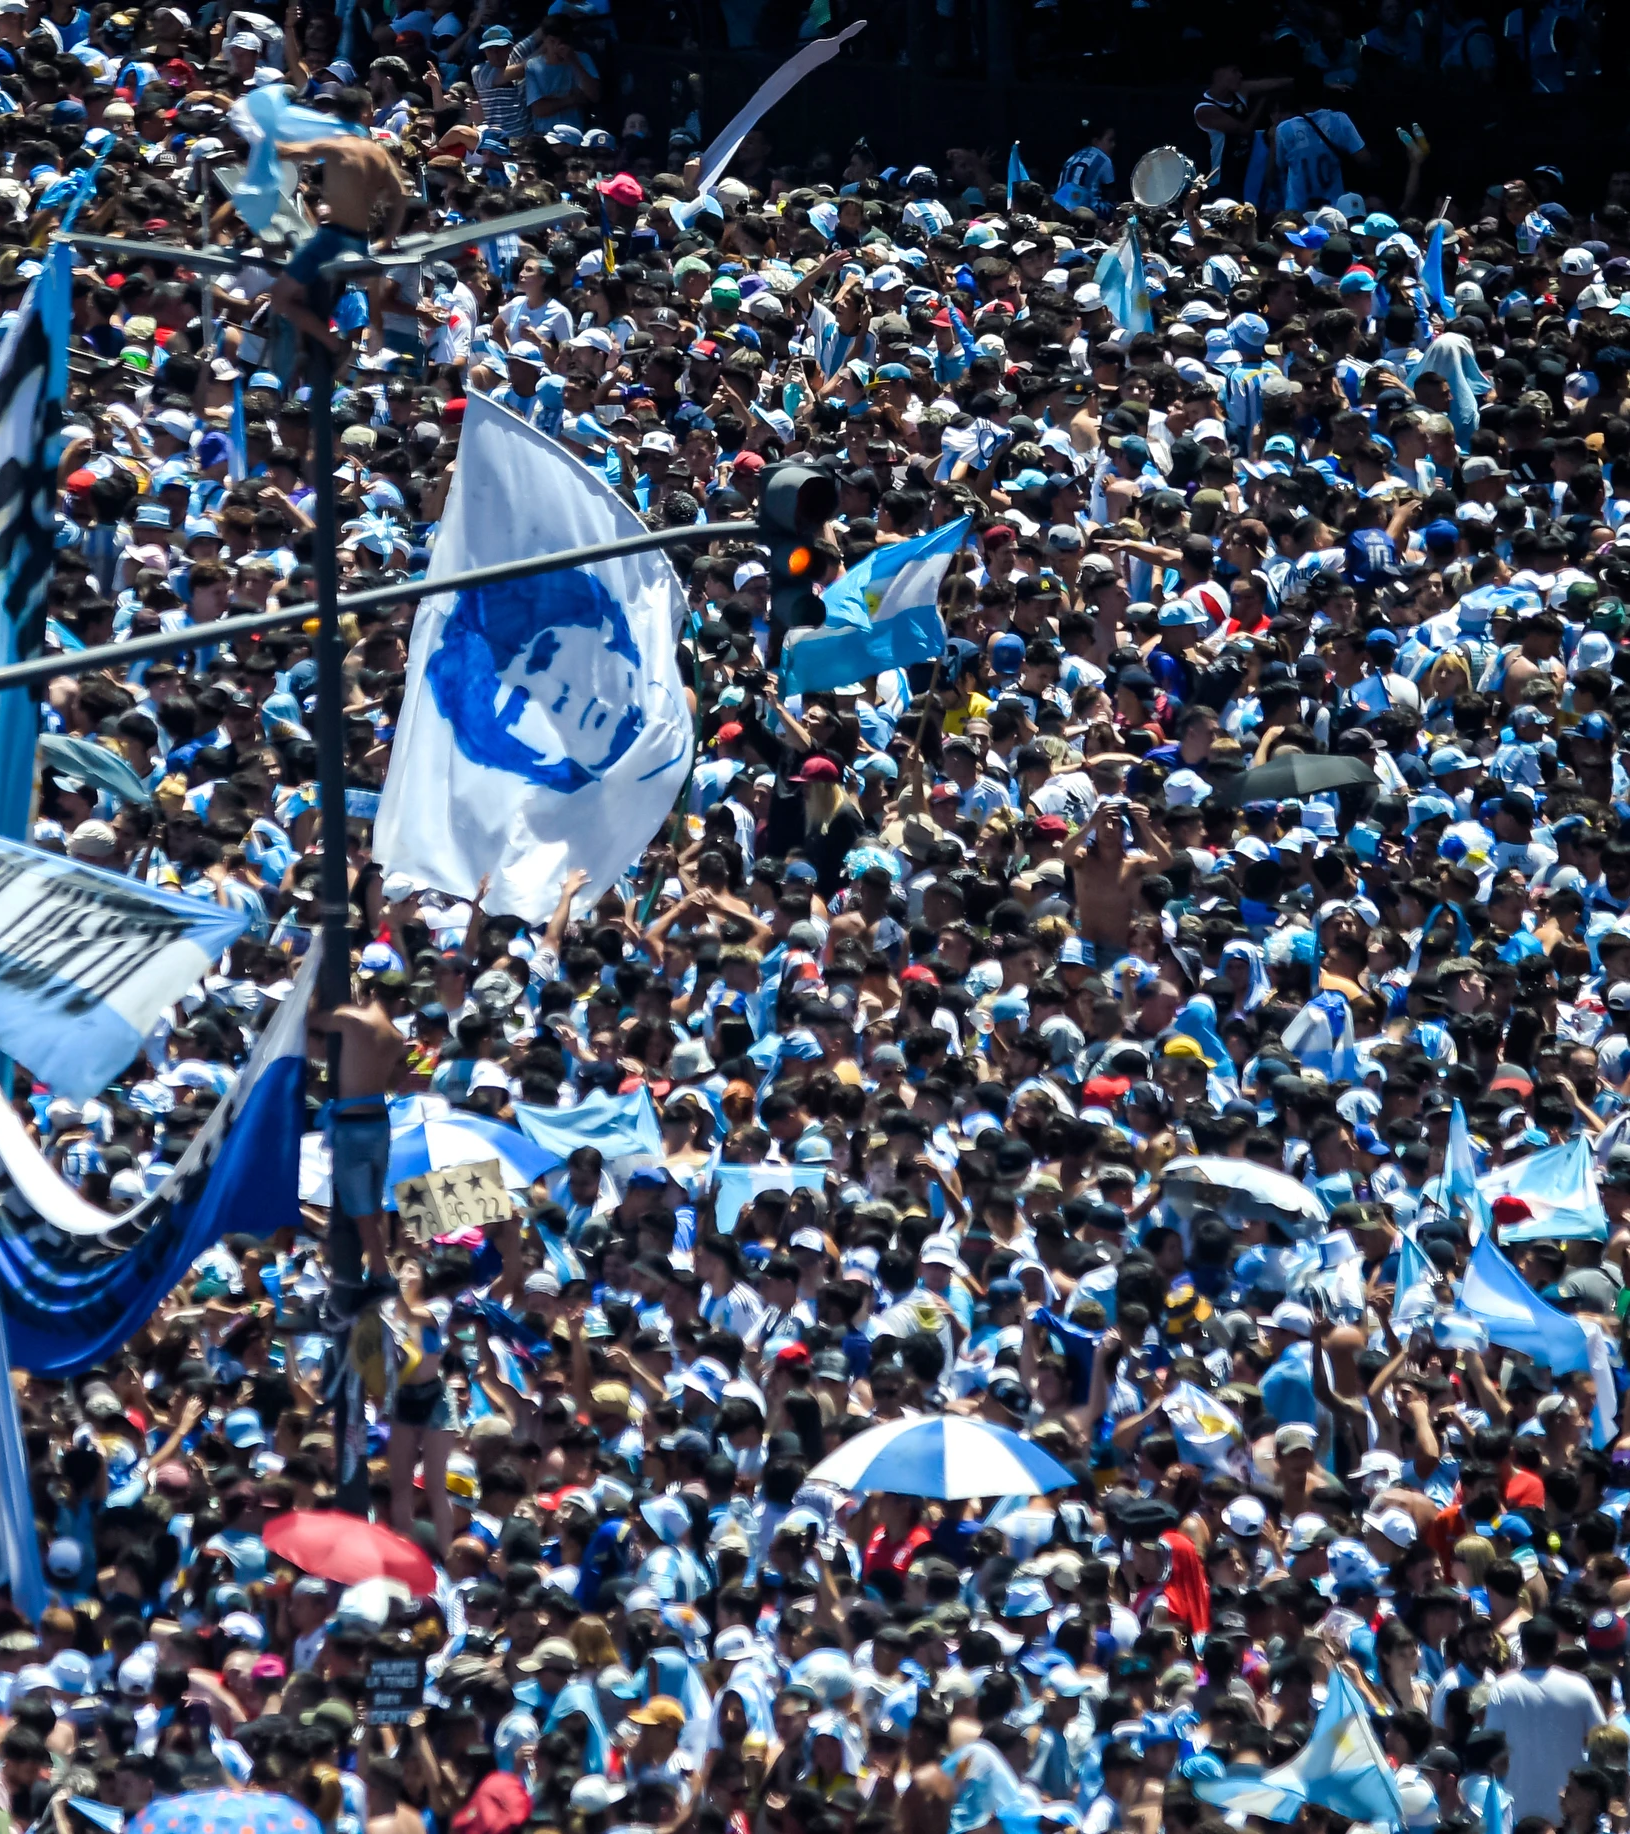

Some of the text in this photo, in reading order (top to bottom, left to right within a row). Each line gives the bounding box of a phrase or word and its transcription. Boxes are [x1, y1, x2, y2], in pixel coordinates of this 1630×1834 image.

[1299, 153, 1333, 198] 10
[406, 1197, 505, 1240] 78 86 22
